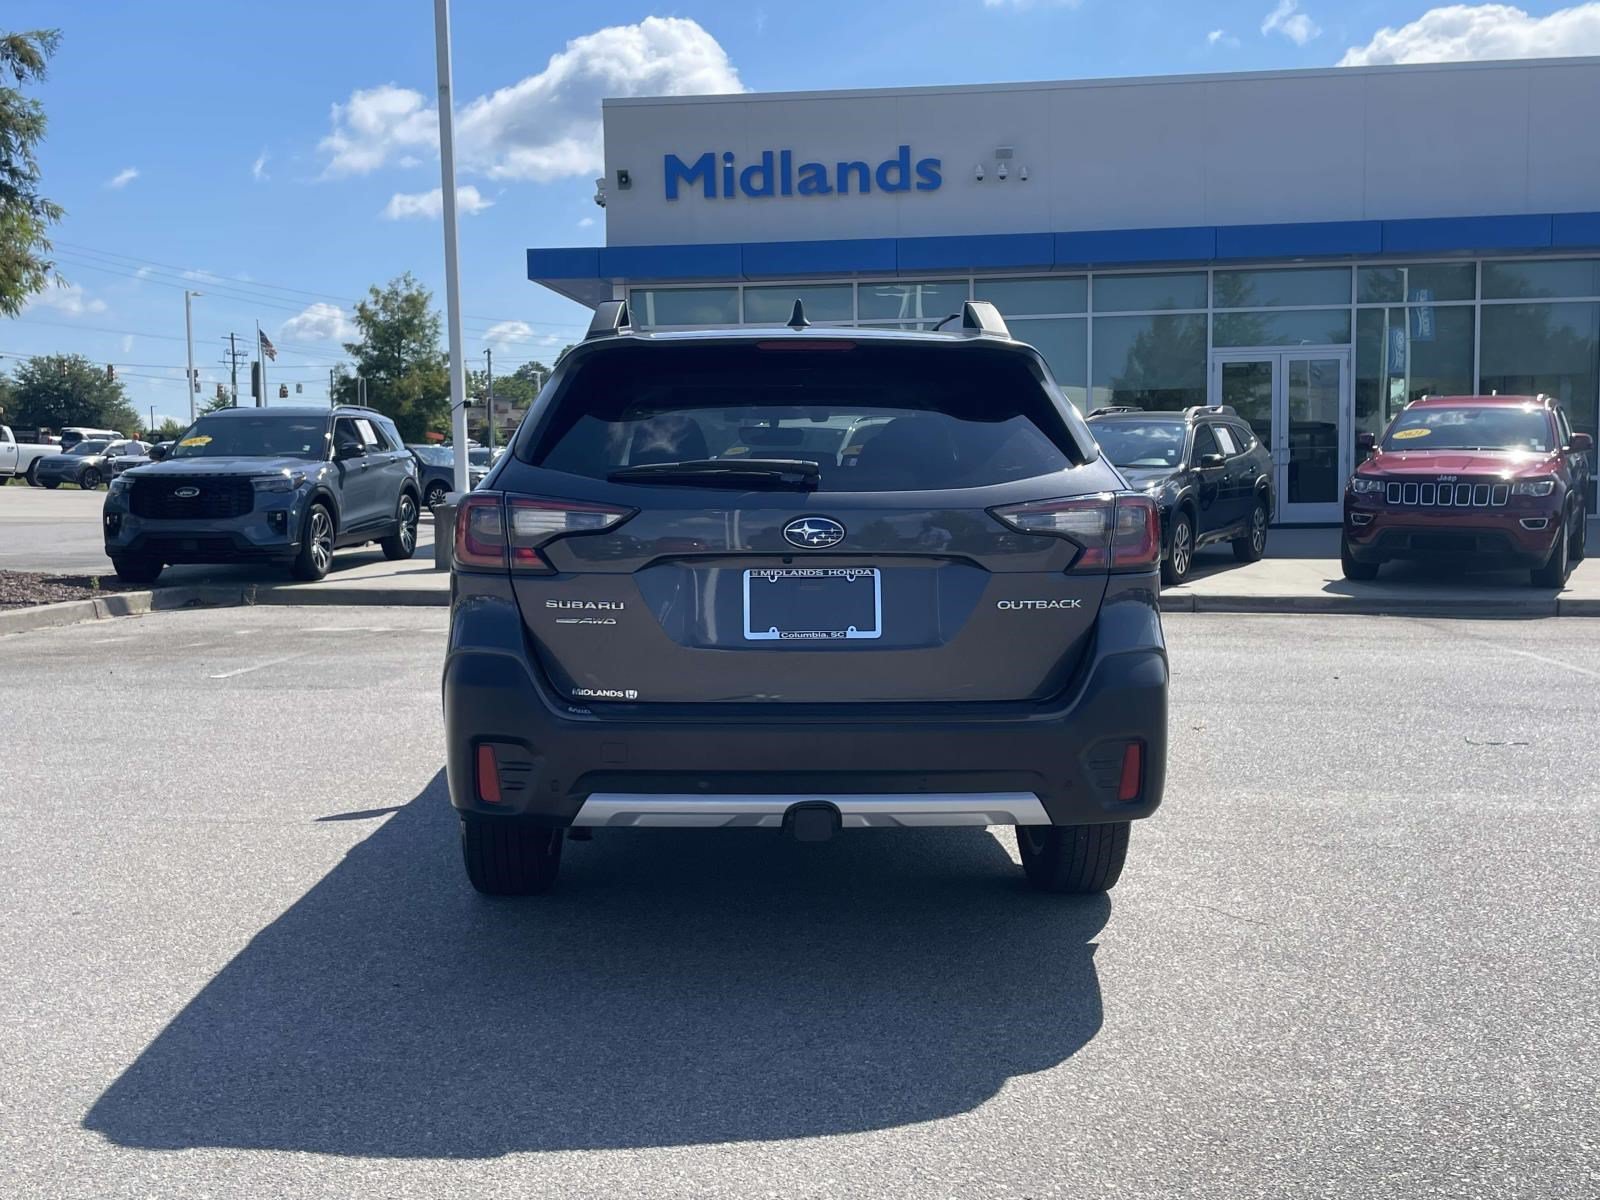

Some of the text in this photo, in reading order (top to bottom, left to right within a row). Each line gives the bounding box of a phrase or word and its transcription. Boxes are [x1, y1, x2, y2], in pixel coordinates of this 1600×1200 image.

[664, 145, 942, 200] Midlands
[1437, 474, 1457, 482] Jeep
[829, 568, 872, 576] HONDA
[545, 600, 625, 610] SUBARU
[997, 599, 1082, 610] OUTBACK
[571, 688, 624, 697] MIDLANDS
